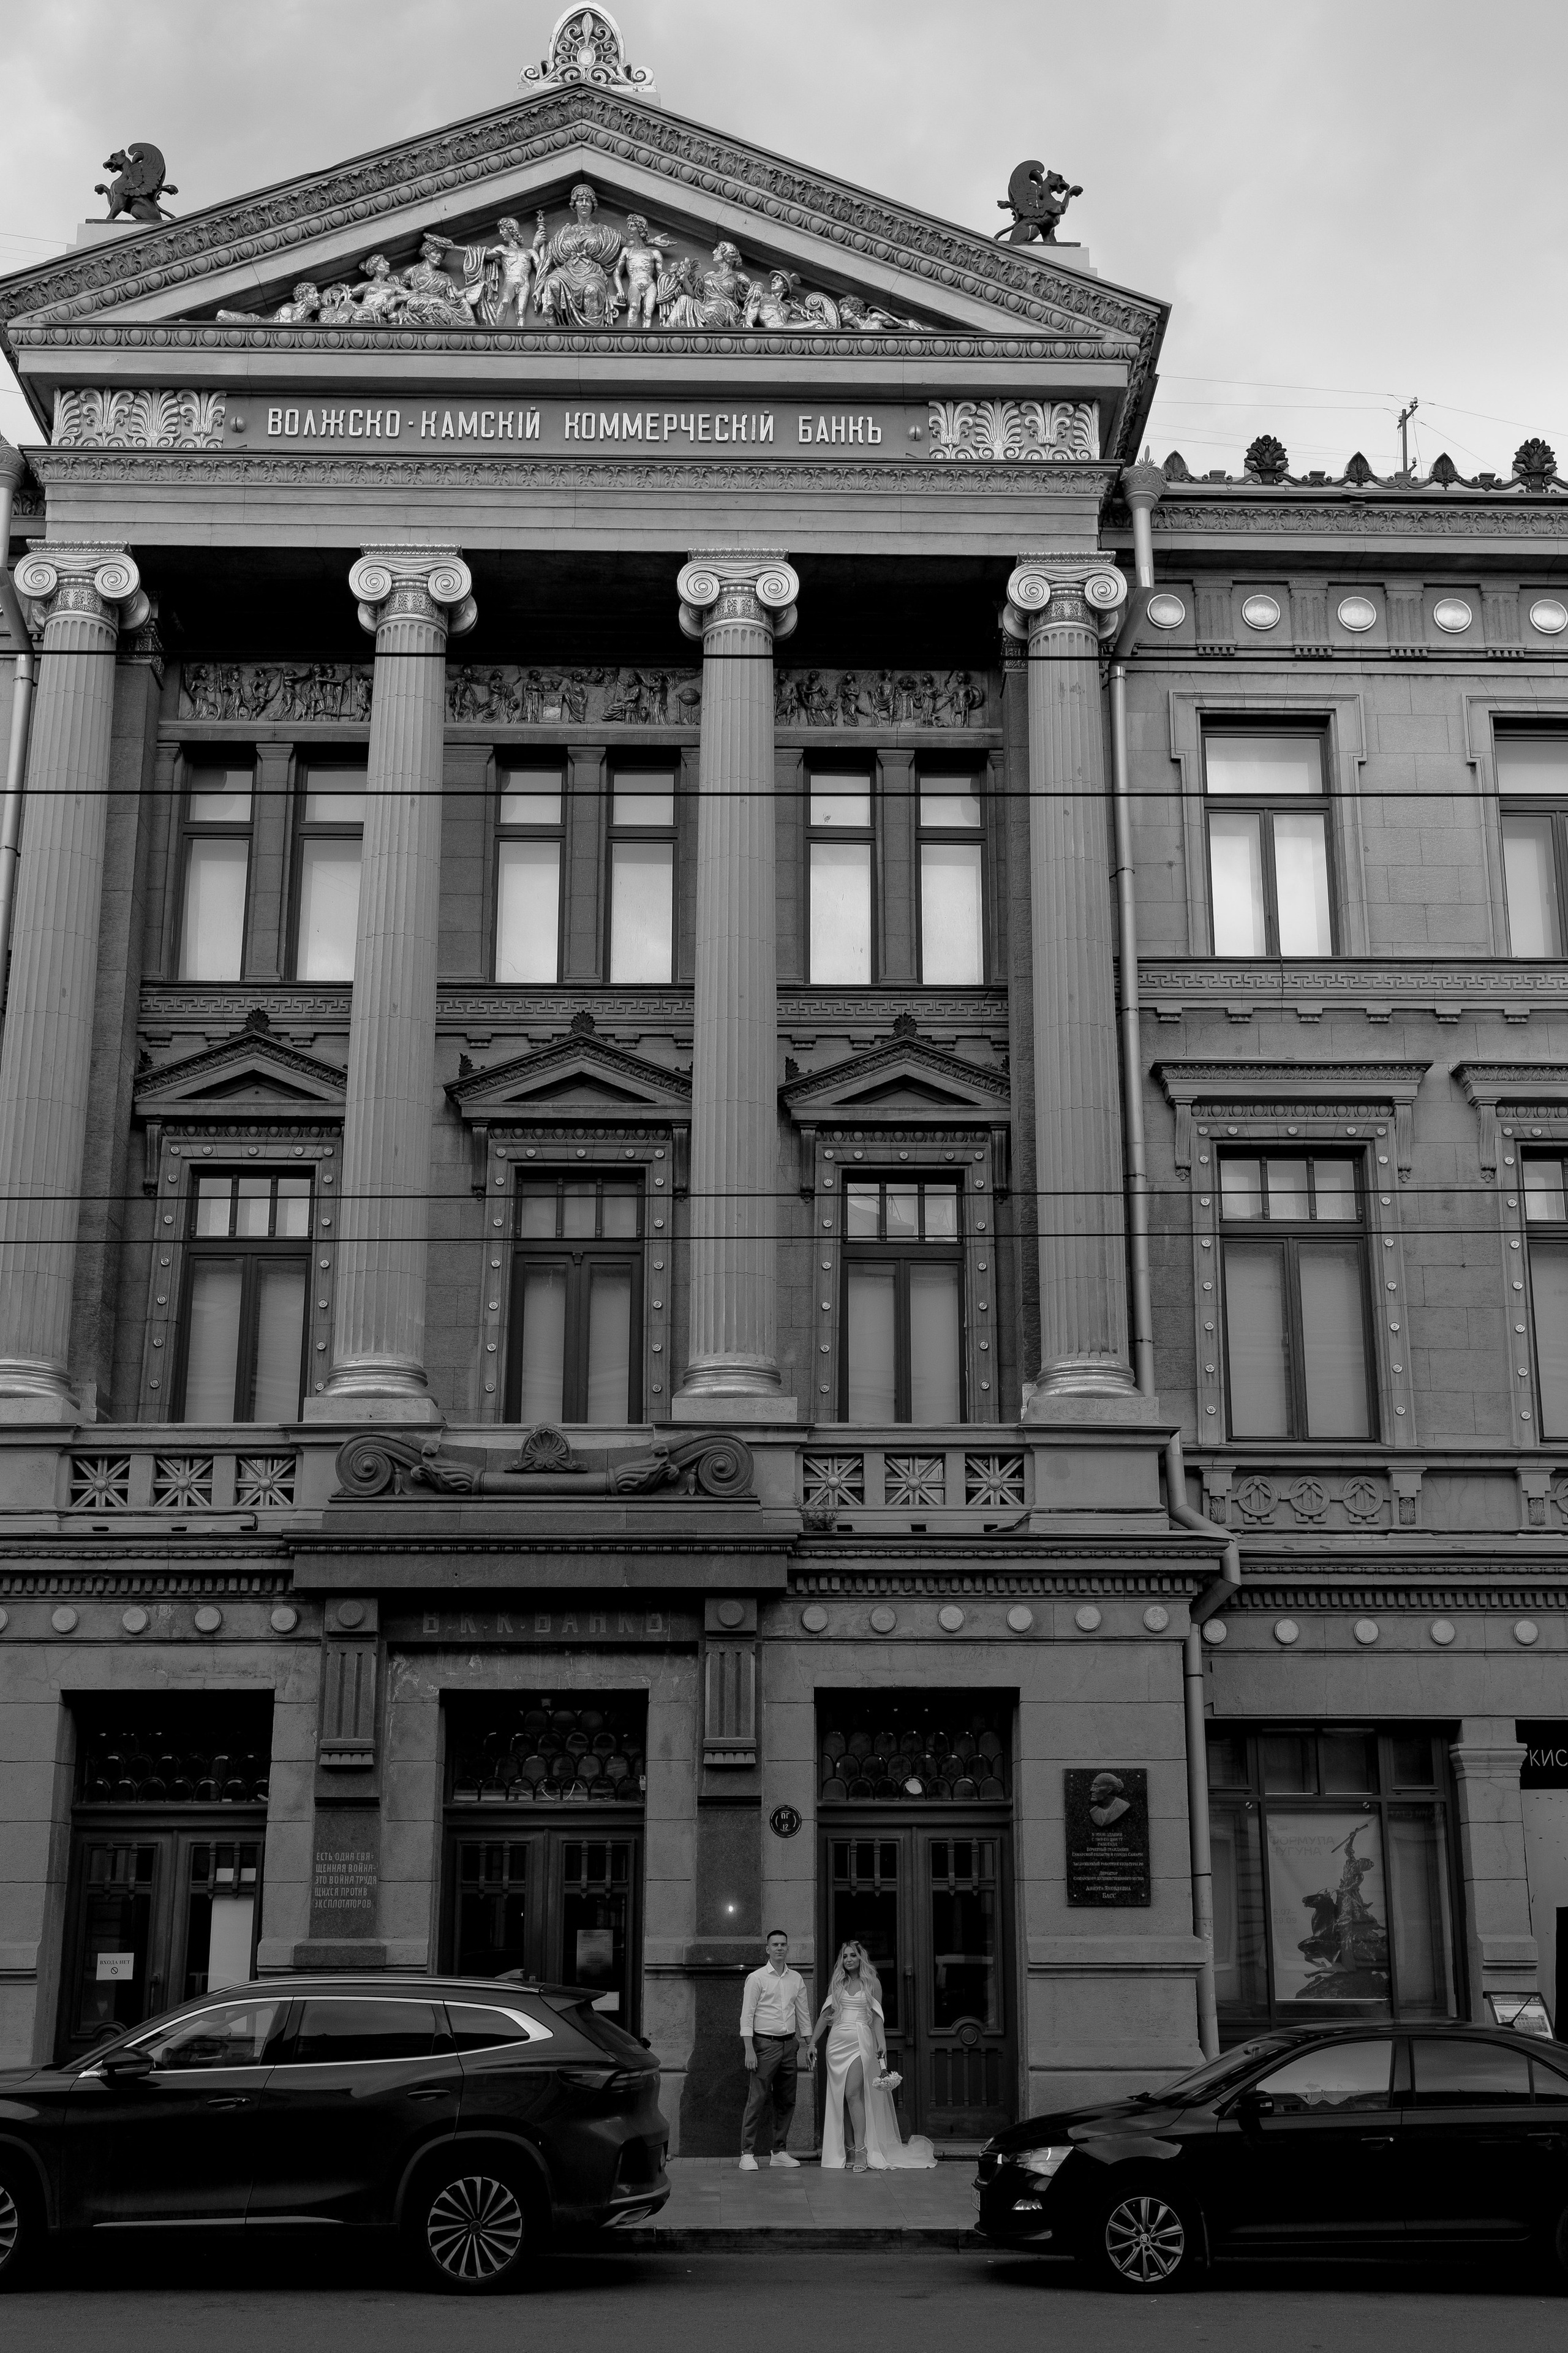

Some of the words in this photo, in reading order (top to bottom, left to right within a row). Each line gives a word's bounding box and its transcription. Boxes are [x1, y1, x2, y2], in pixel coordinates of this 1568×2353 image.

[565, 410, 774, 444] КОММЕРЧЕСКІЙ
[798, 415, 882, 445] БАНКЪ
[1529, 1749, 1568, 1767] КИС
[1269, 1836, 1335, 1845] ФОРМУЛА
[1270, 1846, 1322, 1856] ЧУГУНА
[317, 1852, 333, 1861] ЕСТЬ
[335, 1852, 355, 1861] ОДНА
[315, 1864, 346, 1873] ЩЕННАЯ
[315, 1876, 327, 1884] ЭТО
[329, 1875, 355, 1884] ВОЙНА
[356, 1876, 377, 1885] ТРУДЯ
[315, 1887, 339, 1897] ЩИХСЯ
[341, 1887, 368, 1896] ПРОТИВ
[314, 1899, 372, 1908] ЭКСПЛОТАТОРОВ
